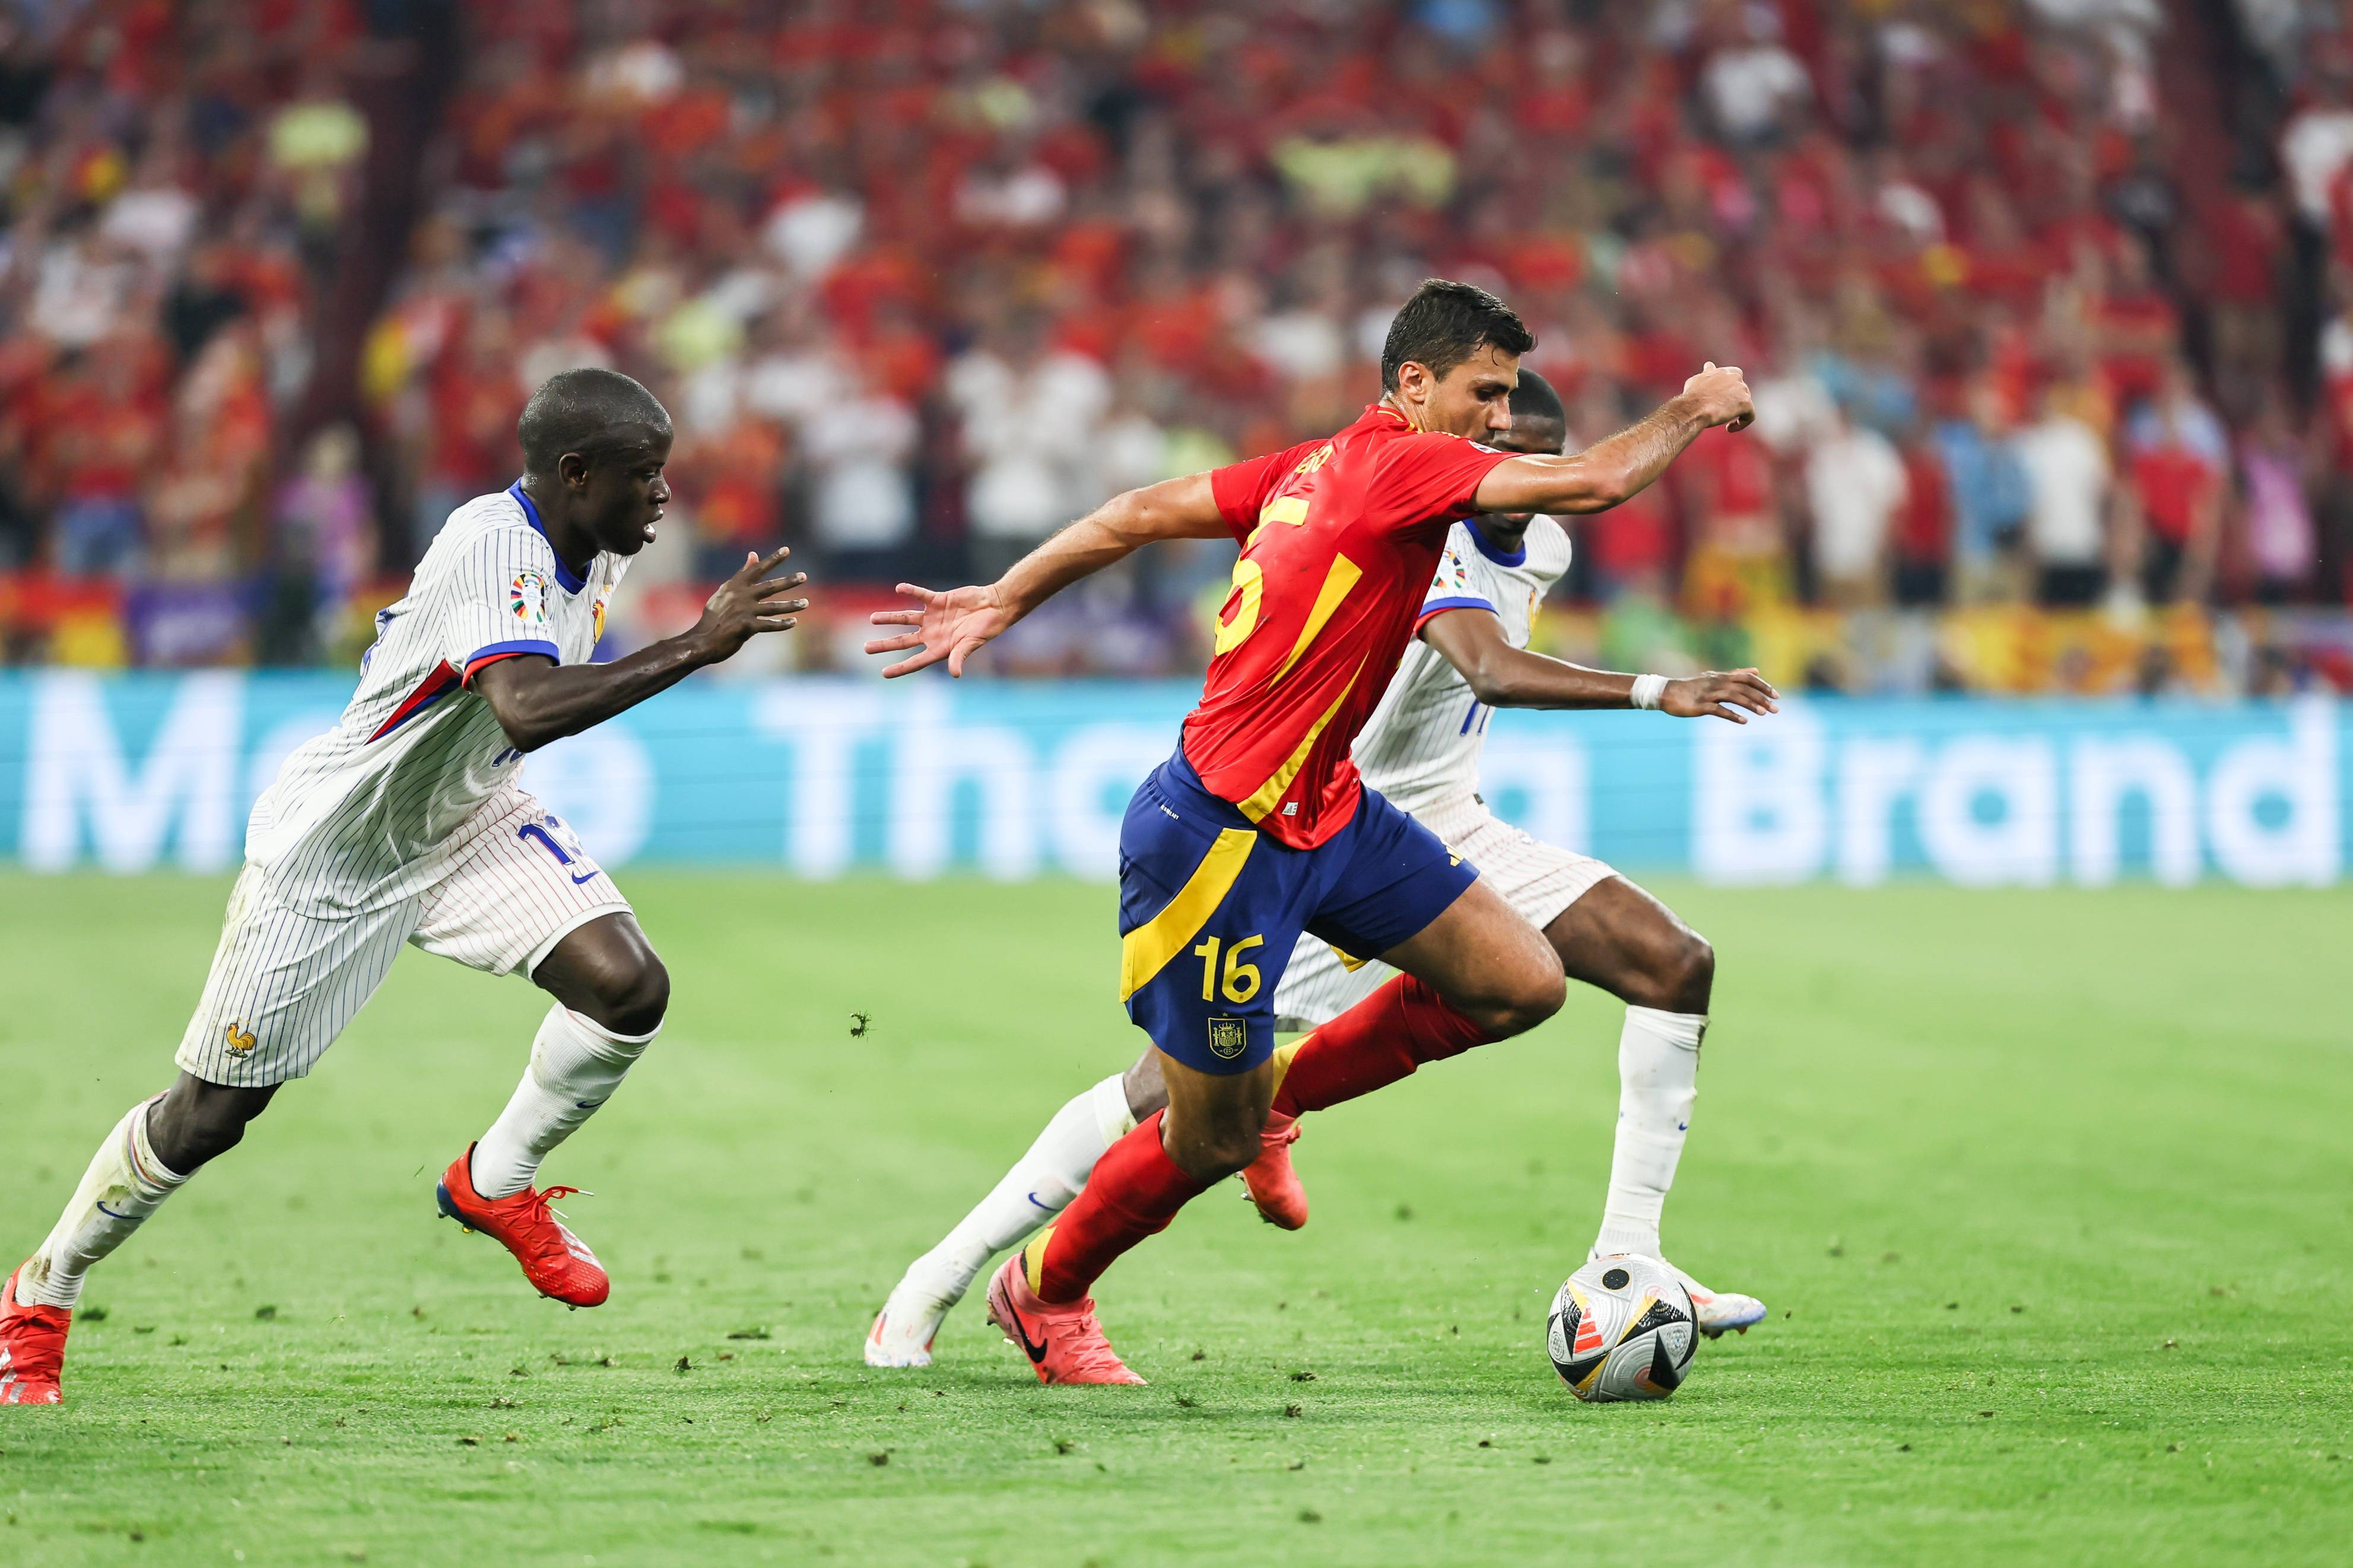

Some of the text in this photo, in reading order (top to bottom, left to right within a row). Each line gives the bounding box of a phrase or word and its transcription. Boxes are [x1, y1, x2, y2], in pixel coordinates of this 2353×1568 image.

[25, 669, 655, 879] Me
[751, 681, 1186, 884] Tha
[1690, 688, 2339, 889] Brand
[1194, 933, 1263, 1003] 16
